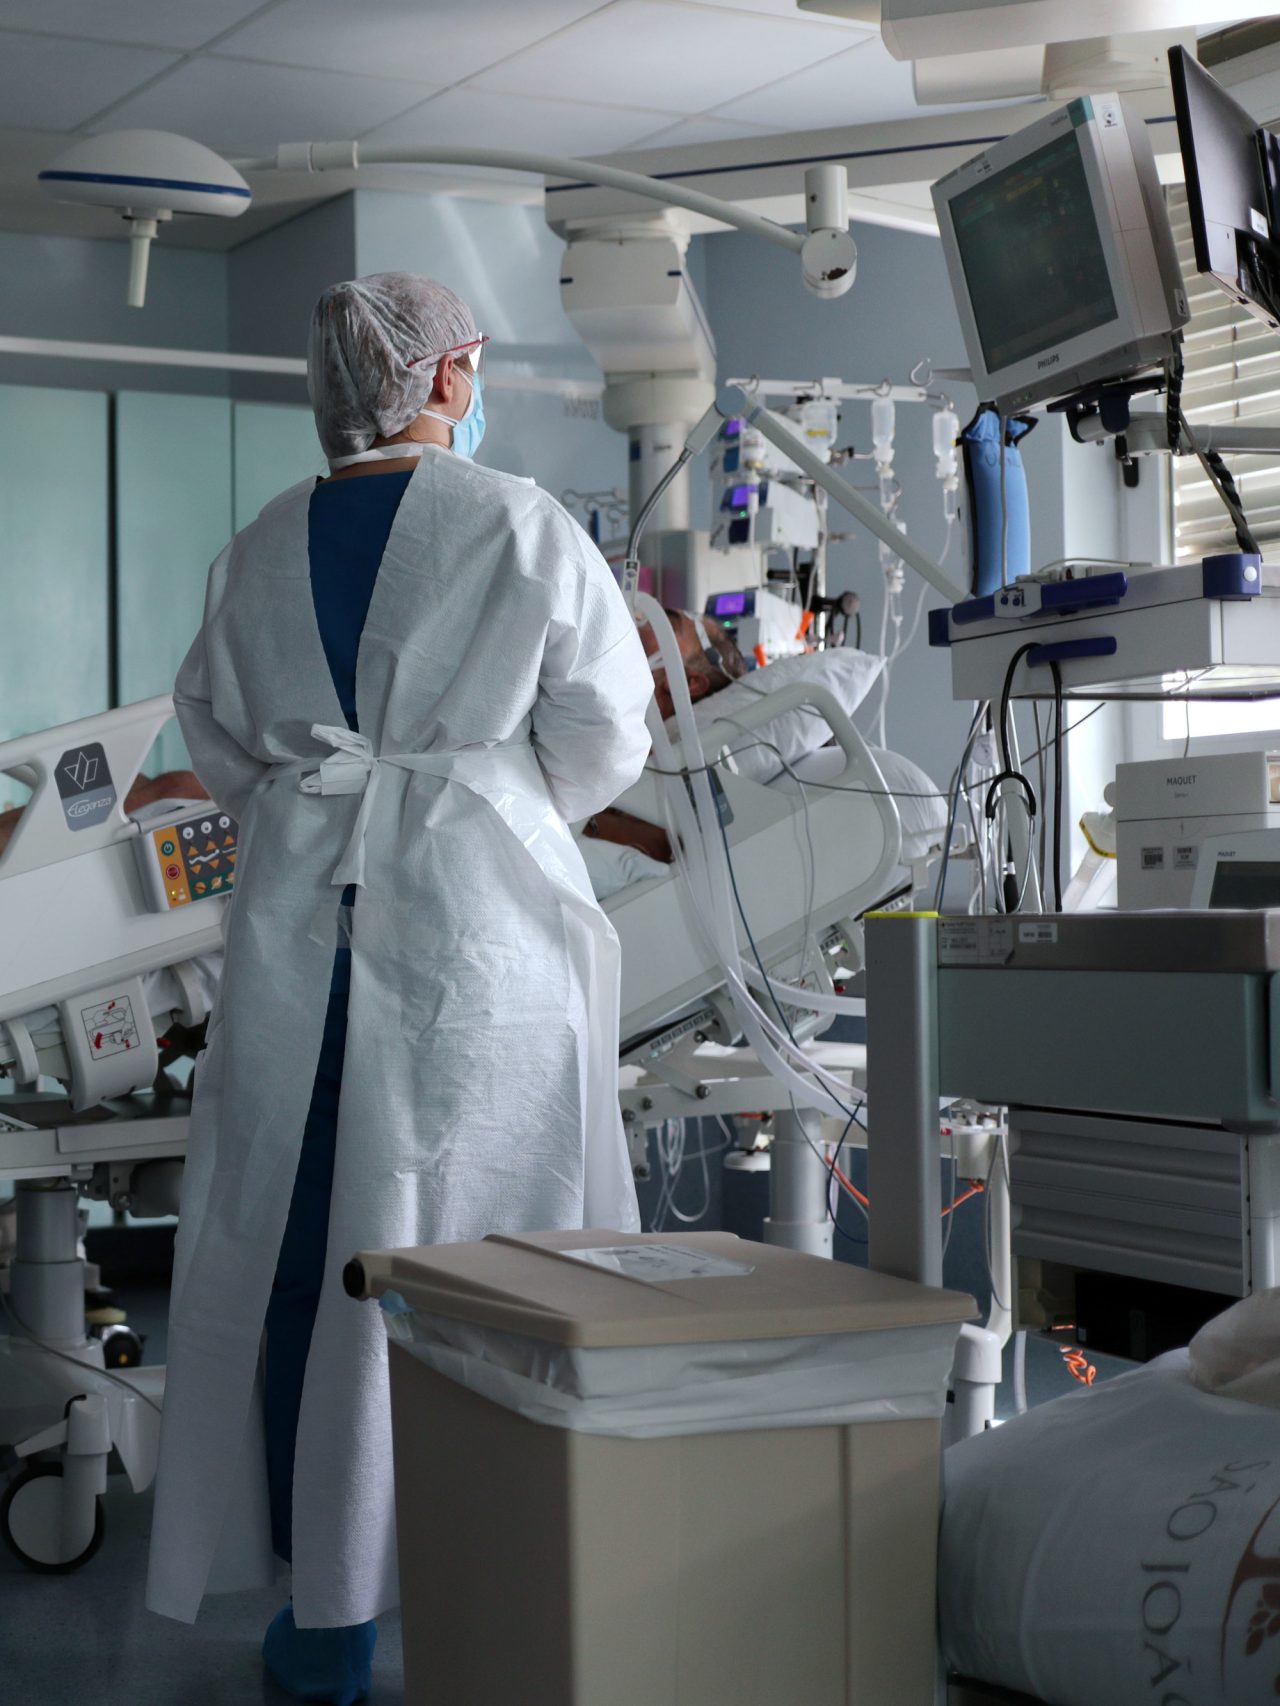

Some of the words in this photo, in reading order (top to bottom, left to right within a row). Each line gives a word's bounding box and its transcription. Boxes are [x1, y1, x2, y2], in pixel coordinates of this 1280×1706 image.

[1038, 354, 1059, 370] PHILIPS
[1166, 775, 1196, 786] MAQUET
[68, 797, 111, 817] Eleganza
[1167, 1460, 1271, 1541] SÃO
[1141, 1562, 1194, 1706] JOÃ
